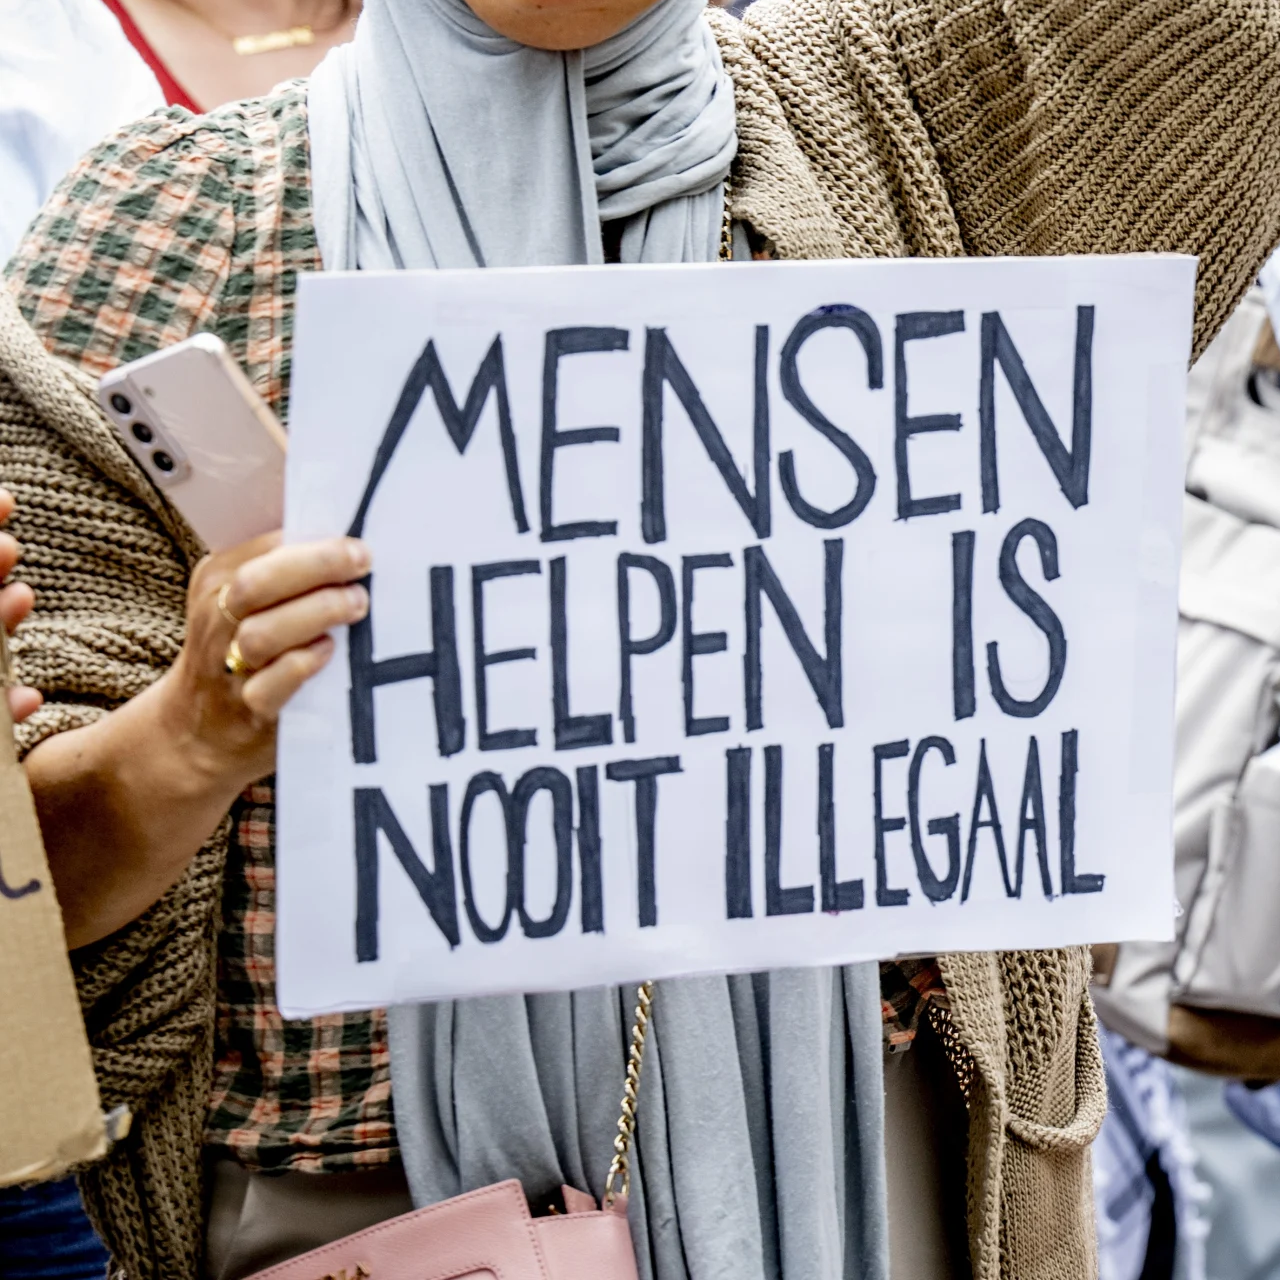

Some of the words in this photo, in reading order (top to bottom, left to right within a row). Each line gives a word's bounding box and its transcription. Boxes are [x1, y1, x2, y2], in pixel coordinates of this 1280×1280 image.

[346, 303, 1095, 544] MENSEN
[346, 537, 844, 764] HELPEN
[951, 517, 1067, 721] IS
[353, 755, 684, 963] NOOIT
[725, 729, 1106, 920] ILLEGAAL
